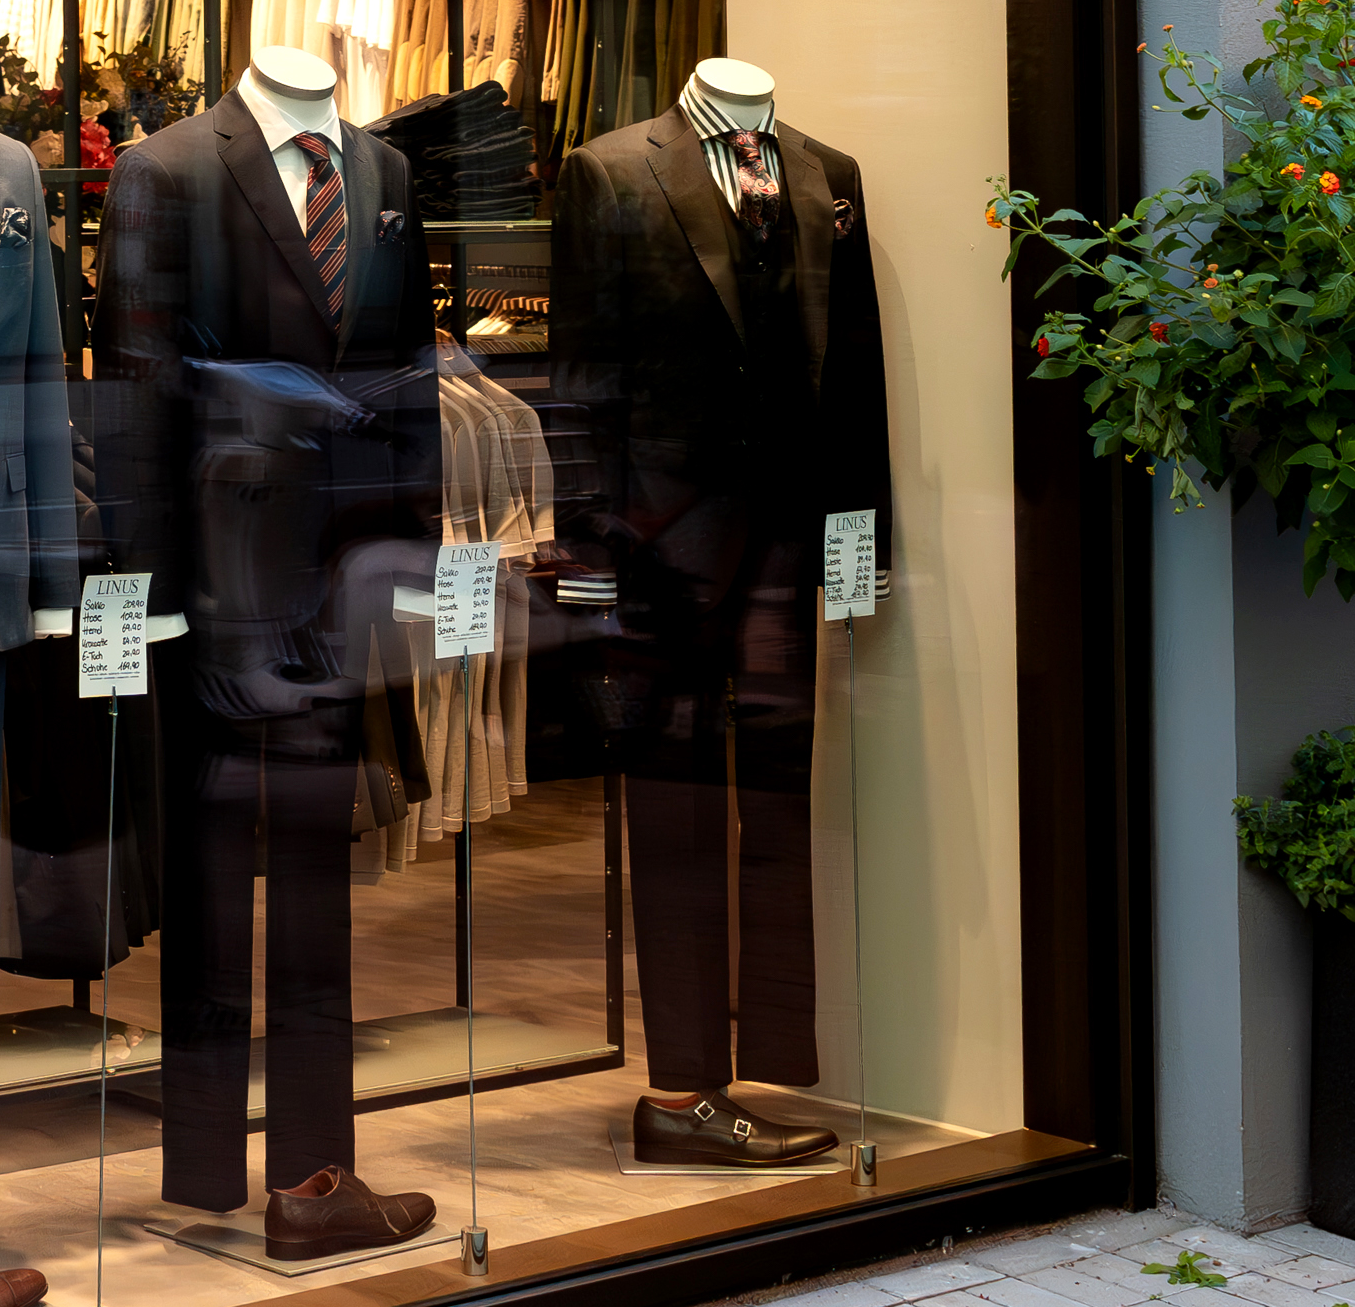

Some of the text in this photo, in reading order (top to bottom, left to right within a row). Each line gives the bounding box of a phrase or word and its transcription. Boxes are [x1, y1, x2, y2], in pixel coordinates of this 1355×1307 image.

[836, 515, 867, 532] LINUS
[450, 546, 491, 563] LINUS
[96, 578, 139, 595] LINUS
